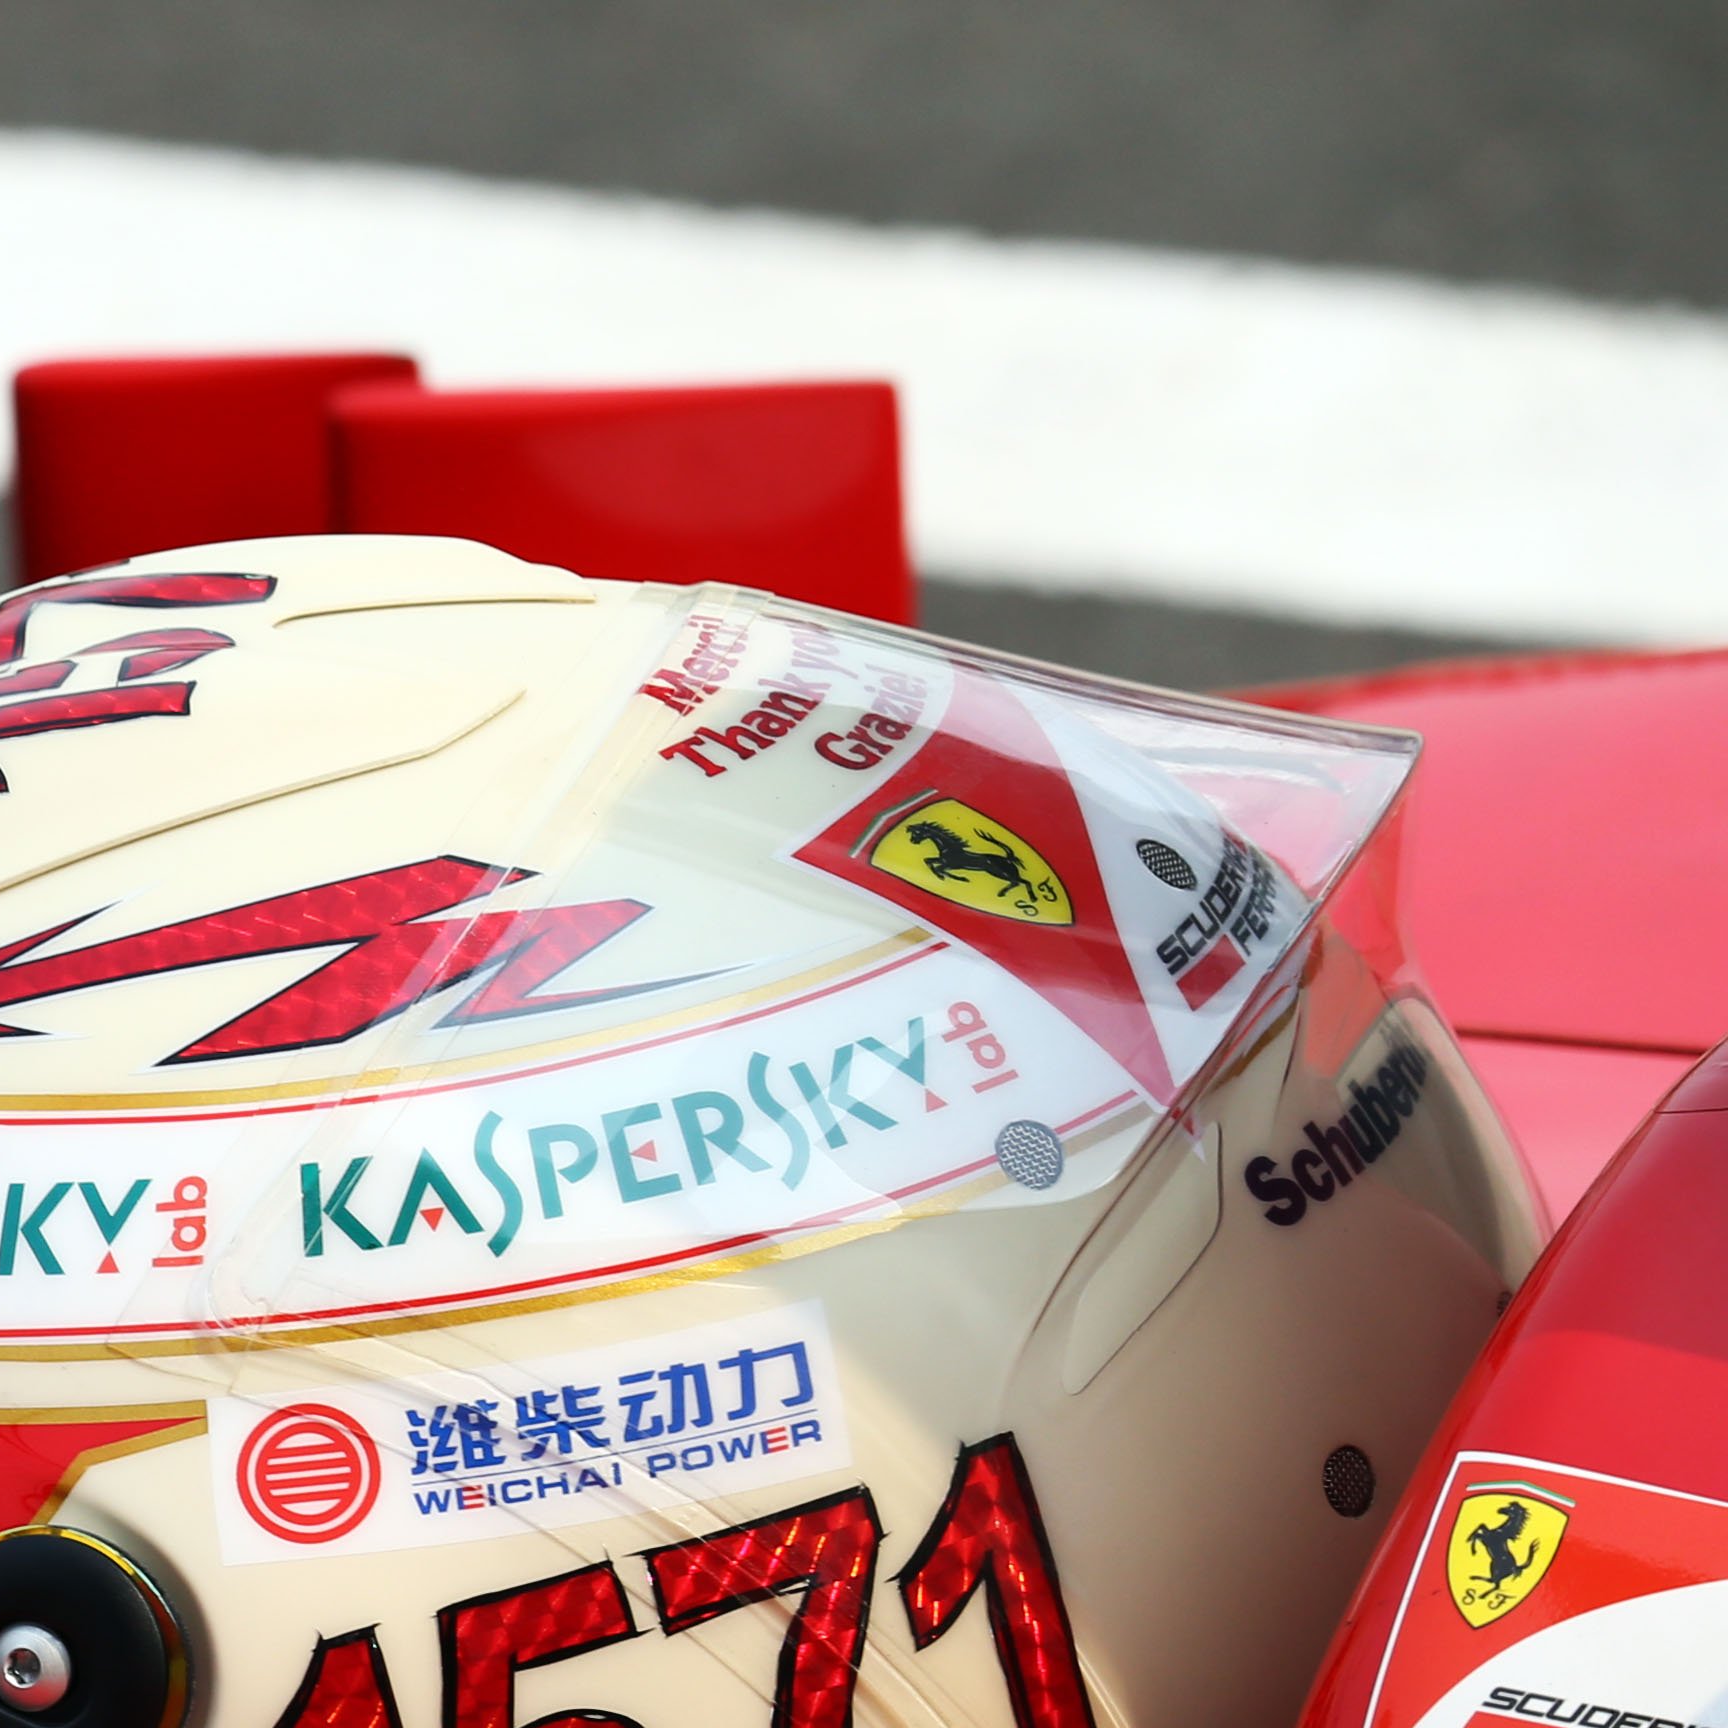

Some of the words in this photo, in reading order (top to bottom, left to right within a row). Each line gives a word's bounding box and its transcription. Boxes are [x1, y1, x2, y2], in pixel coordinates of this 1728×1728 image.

[658, 672, 833, 778] Thank
[813, 662, 928, 771] Grazie!
[300, 1016, 949, 1257] KASPERSKY
[941, 1001, 1020, 1094] lab
[152, 1175, 208, 1268] lab
[405, 1341, 816, 1476] 潍柴动力
[413, 1462, 623, 1516] WEICHAI
[649, 1419, 824, 1478] POWER
